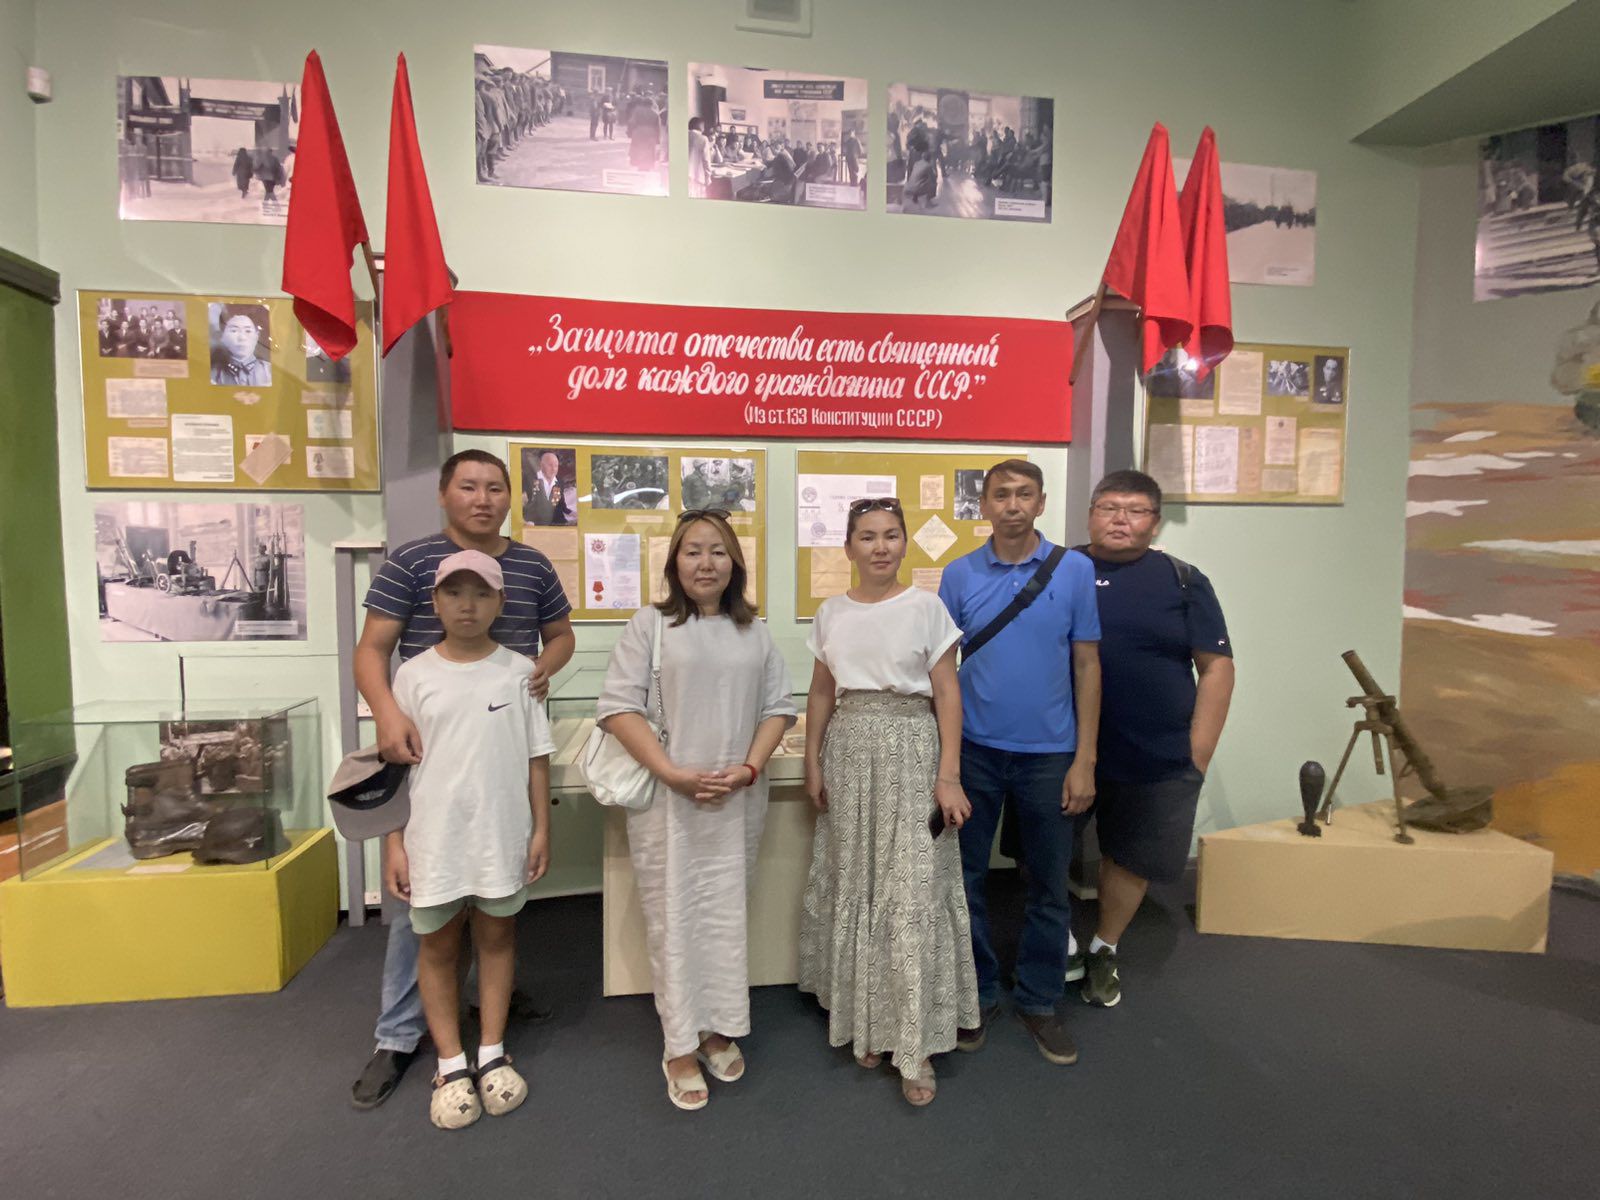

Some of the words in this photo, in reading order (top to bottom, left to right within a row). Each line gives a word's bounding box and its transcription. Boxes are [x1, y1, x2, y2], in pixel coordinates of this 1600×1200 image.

[683, 324, 813, 361] отечества
[815, 338, 865, 364] есть
[867, 331, 1001, 371] священный
[566, 364, 628, 400] долг
[637, 361, 750, 396] каждого
[754, 365, 906, 402] гражданина
[744, 401, 766, 425] (Из
[811, 407, 894, 429] Конституции
[896, 408, 943, 430] СССР)
